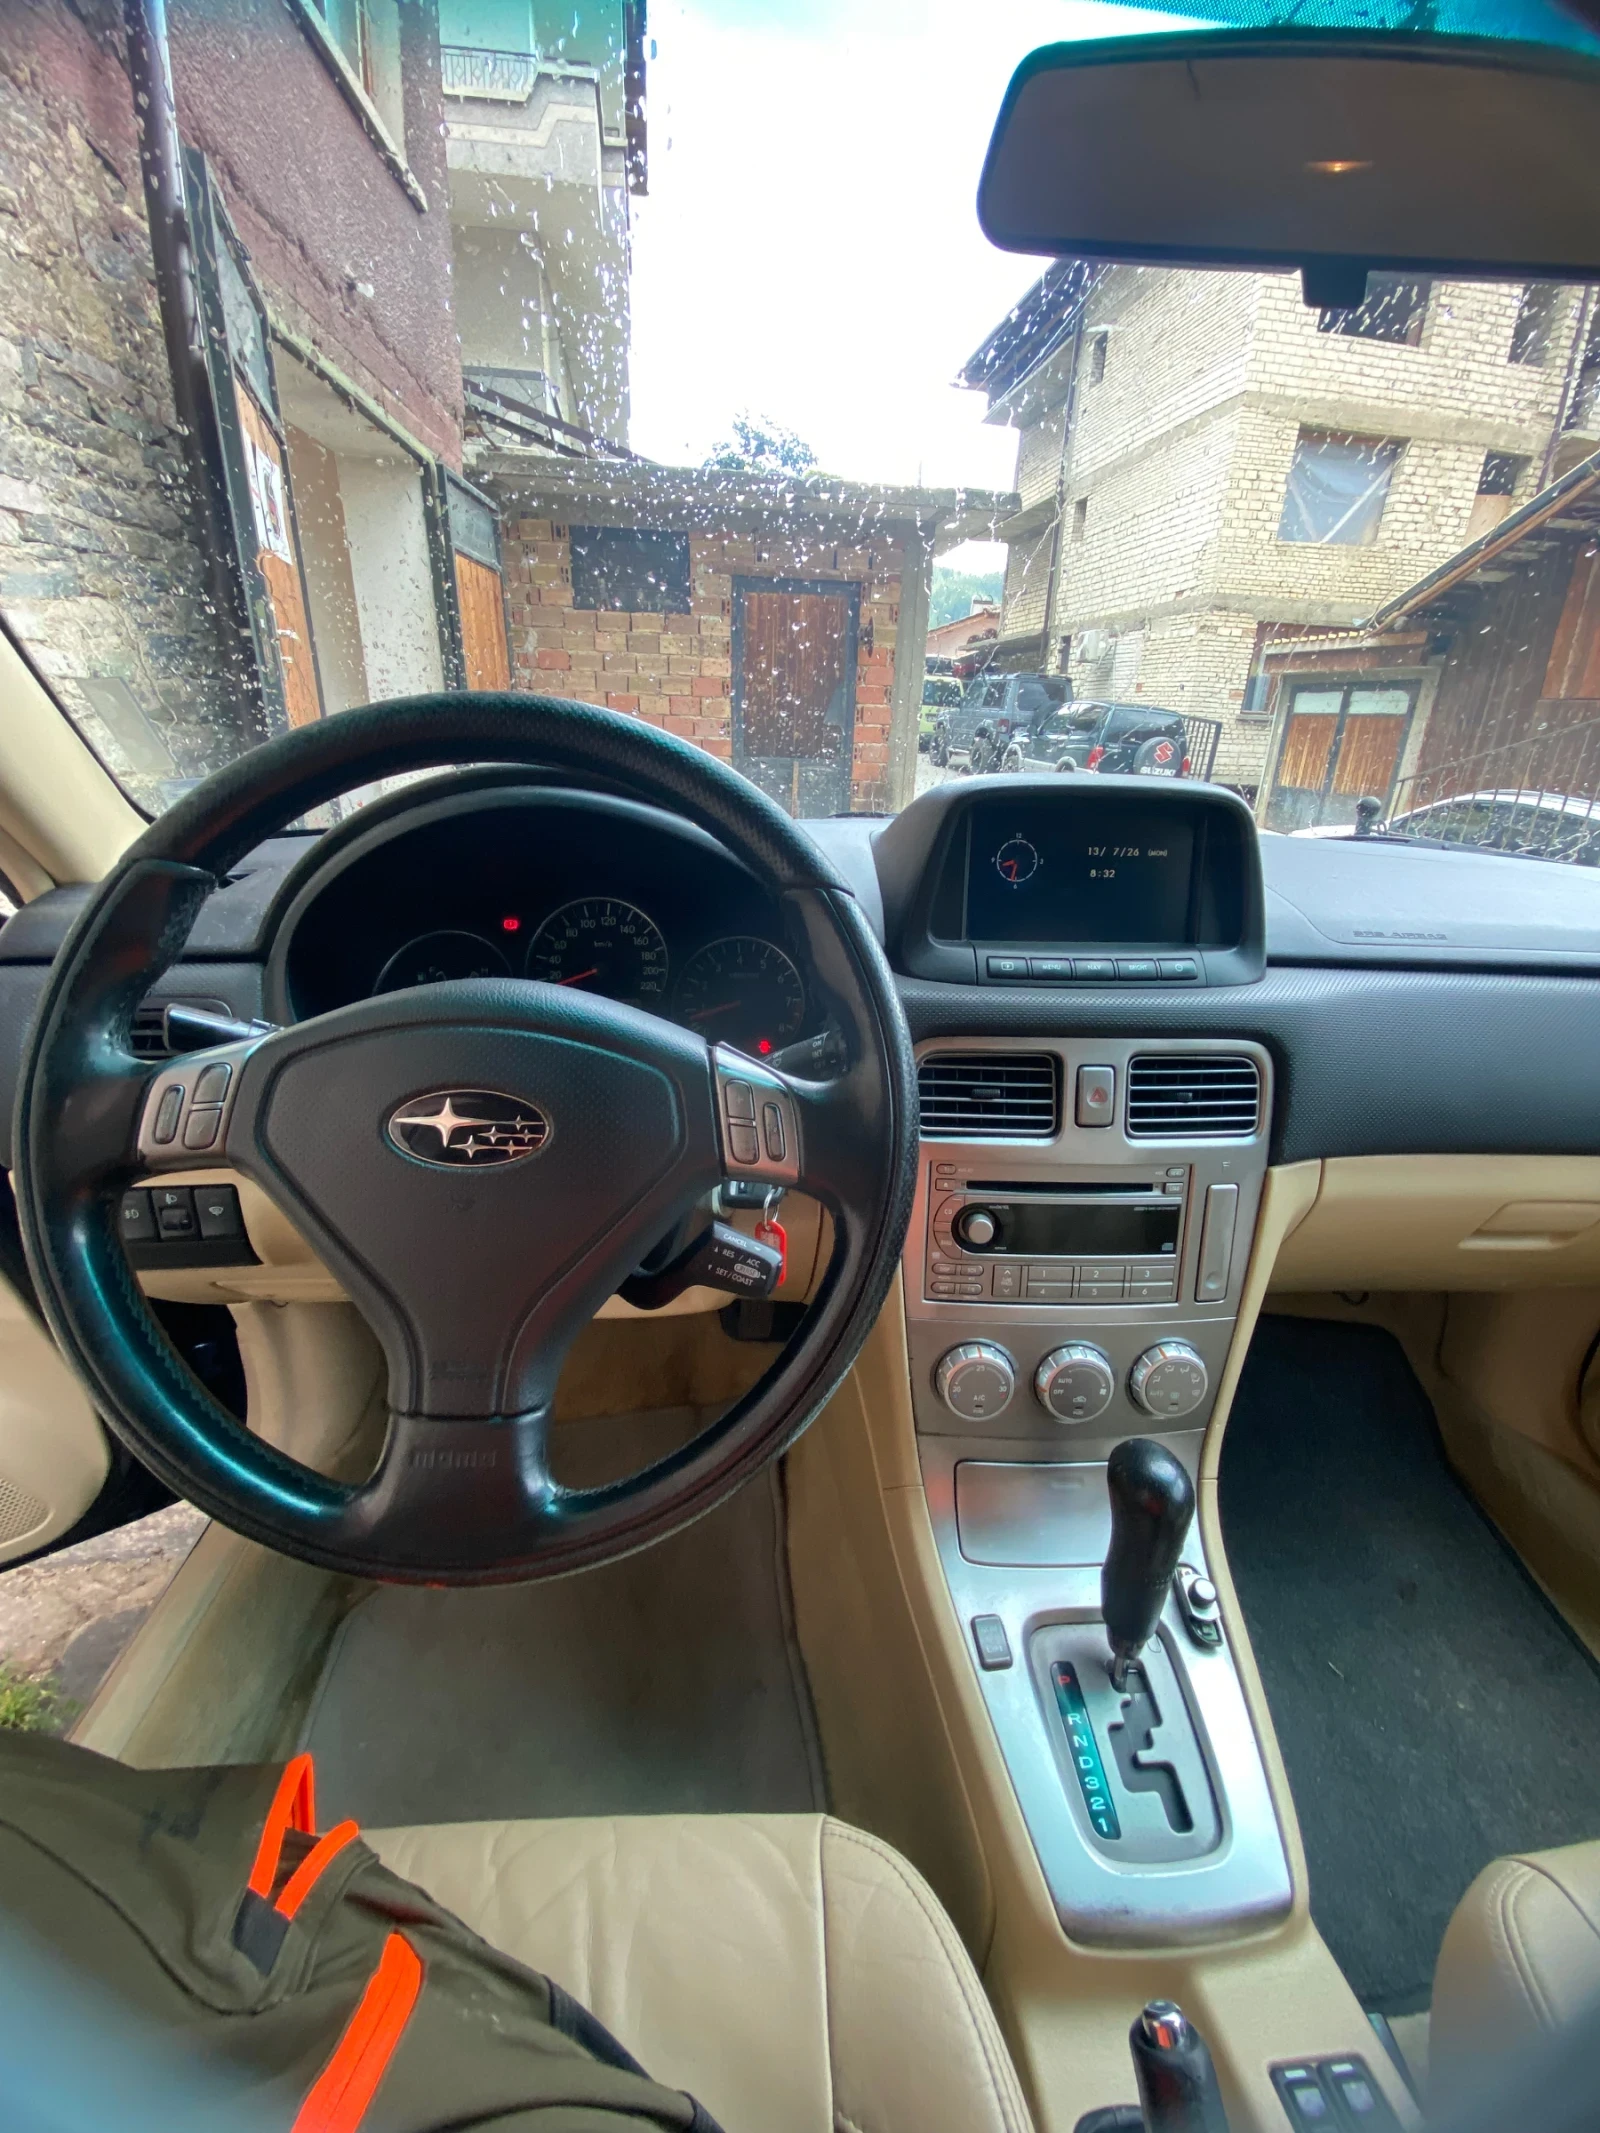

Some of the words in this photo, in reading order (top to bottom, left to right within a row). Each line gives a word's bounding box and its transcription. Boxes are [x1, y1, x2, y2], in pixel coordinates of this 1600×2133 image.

[1139, 766, 1176, 777] SUZUKI
[1113, 847, 1139, 857] 7/26
[1090, 869, 1115, 878] 8:32
[580, 920, 596, 929] 100
[601, 917, 616, 926] 120
[620, 925, 636, 934] 140
[554, 941, 567, 950] 60
[633, 937, 649, 946] 160
[549, 955, 561, 964] 40
[641, 952, 656, 961] 180
[643, 967, 659, 975] 200
[641, 982, 657, 990] 220
[723, 1233, 748, 1248] CANCEL
[722, 1248, 736, 1259] RES
[746, 1258, 761, 1268] ACC
[1093, 1270, 1099, 1278] 2
[1144, 1270, 1150, 1278] 3
[976, 1364, 985, 1372] 25
[998, 1385, 1008, 1393] 30
[1057, 1675, 1071, 1685] P
[1067, 1712, 1082, 1726] R
[1072, 1734, 1089, 1748] N
[1078, 1755, 1094, 1769] D
[1084, 1776, 1100, 1790] 3
[1090, 1796, 1107, 1811] 2
[1098, 1817, 1109, 1833] 1
